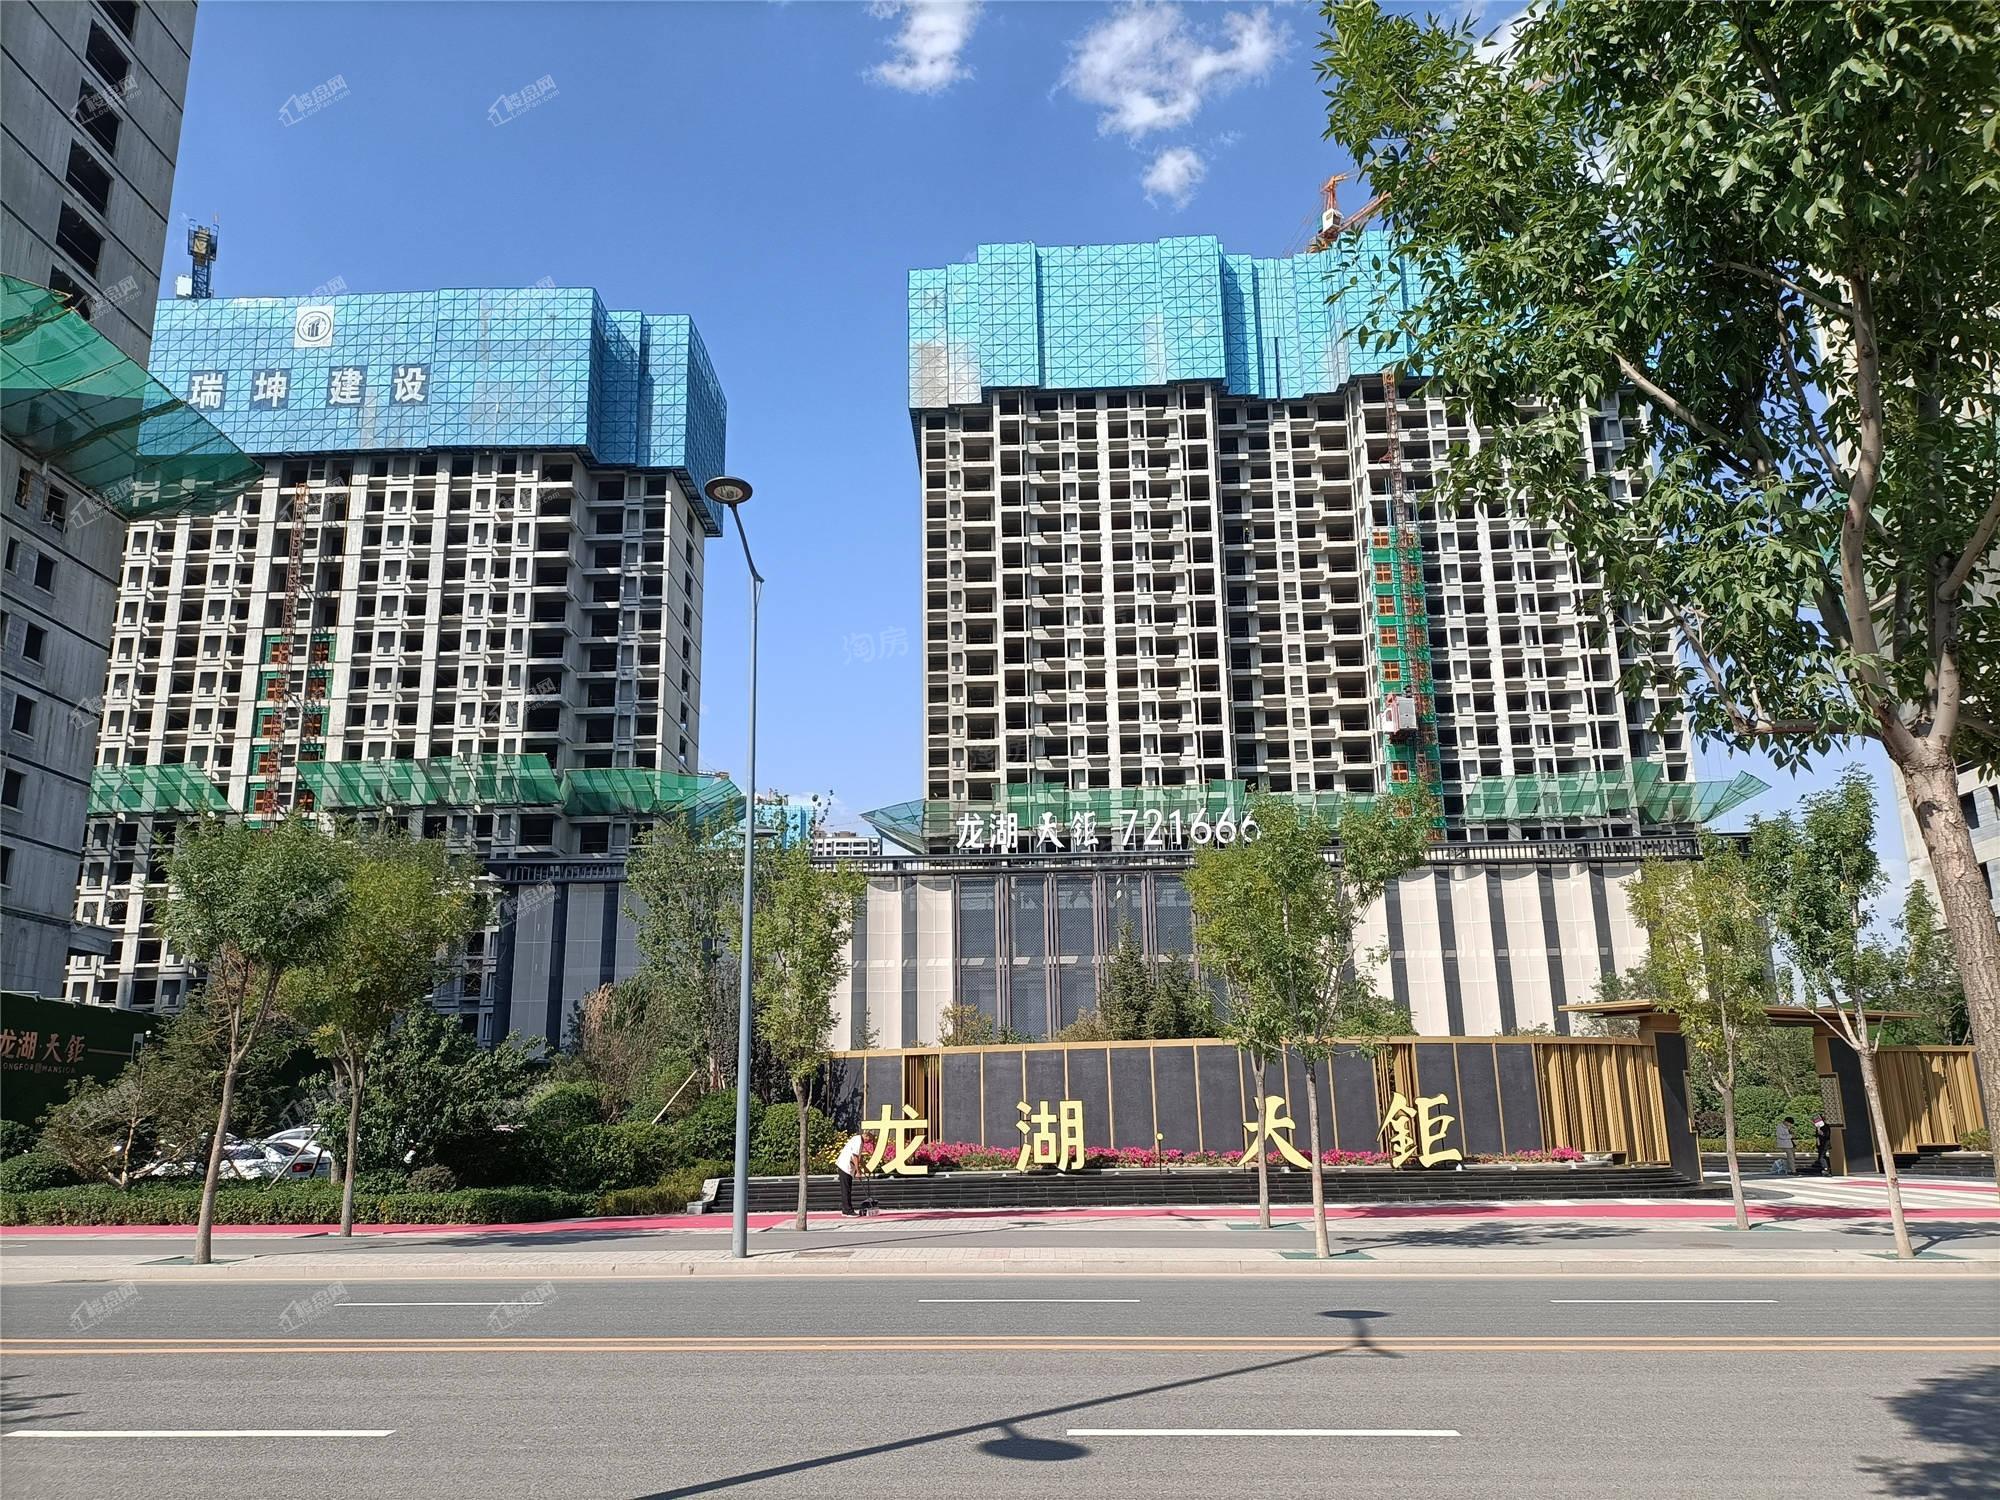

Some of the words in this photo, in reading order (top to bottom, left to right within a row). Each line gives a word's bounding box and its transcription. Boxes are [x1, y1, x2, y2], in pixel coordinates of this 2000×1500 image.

[188, 367, 426, 409] 瑞坤建设
[1119, 808, 1261, 845] 721666
[2, 1062, 34, 1071] ONGFOR
